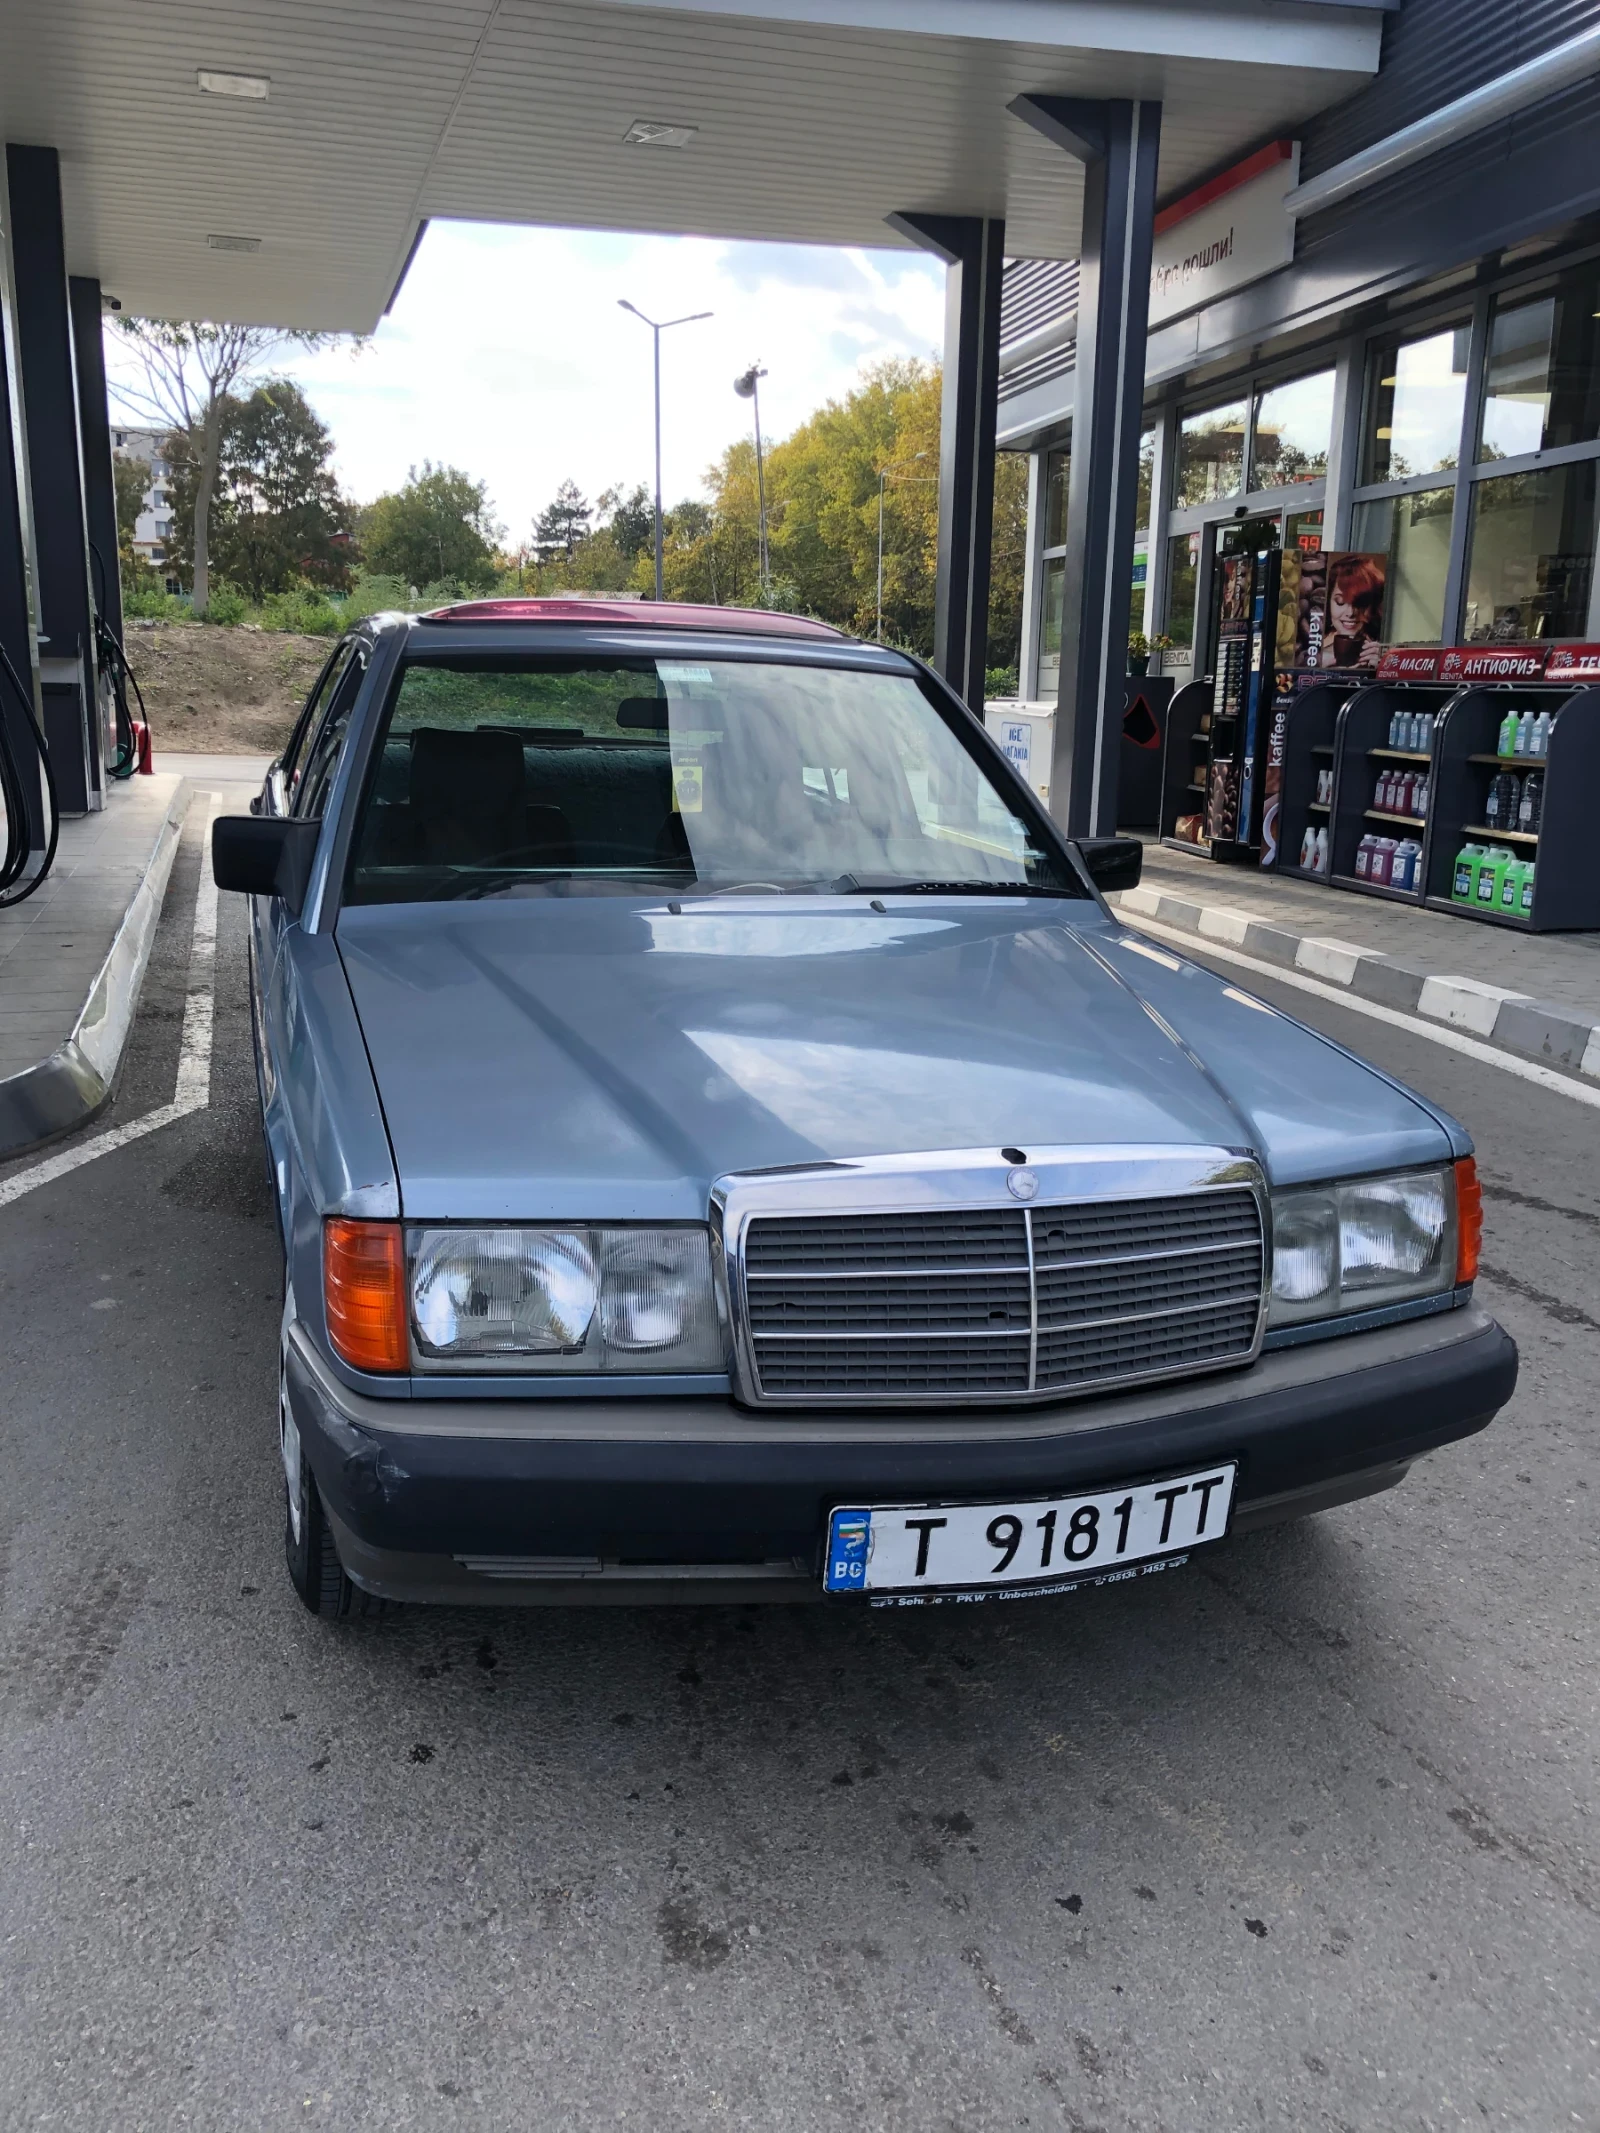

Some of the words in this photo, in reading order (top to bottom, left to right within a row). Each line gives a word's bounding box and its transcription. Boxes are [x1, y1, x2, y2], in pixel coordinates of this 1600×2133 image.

[1306, 612, 1324, 667] kaffee
[1164, 651, 1191, 663] BENITA
[1399, 658, 1435, 671] МАСЛА
[1579, 656, 1600, 673] ТЕ
[1463, 658, 1536, 675] АНТИФРИЗ
[1440, 672, 1463, 680] BENITA
[1268, 712, 1286, 767] kaffee
[904, 1517, 947, 1577] T
[986, 1496, 1134, 1573] 9181
[1154, 1475, 1224, 1544] TT
[834, 1561, 863, 1579] BG
[956, 1593, 986, 1603] PKW
[998, 1582, 1078, 1600] Unbescheiden
